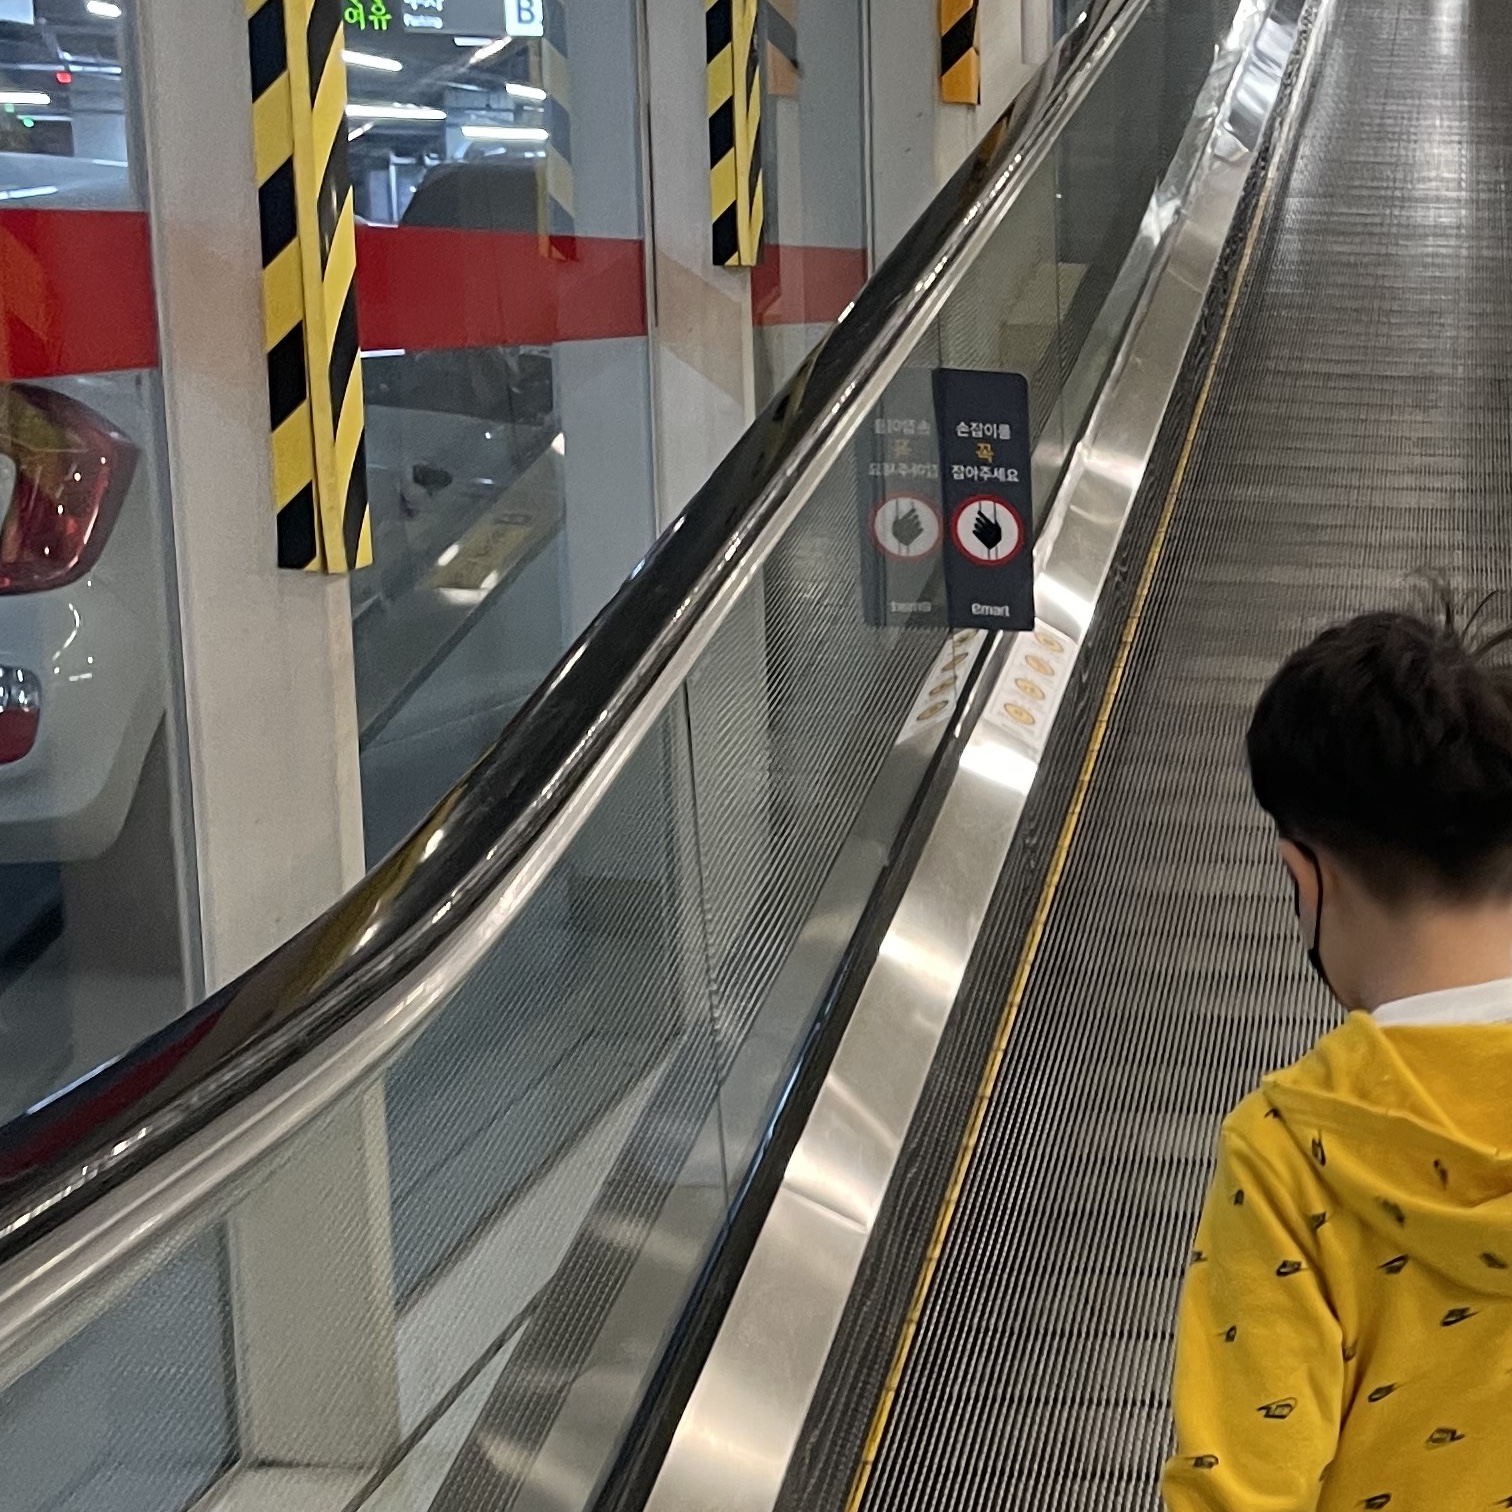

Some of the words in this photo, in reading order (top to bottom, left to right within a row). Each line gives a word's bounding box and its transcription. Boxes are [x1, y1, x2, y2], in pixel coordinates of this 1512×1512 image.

[956, 421, 1011, 439] 손잡이를
[976, 443, 994, 463] 꼭
[951, 464, 1019, 482] 잡아주세요
[971, 603, 1010, 617] emart
